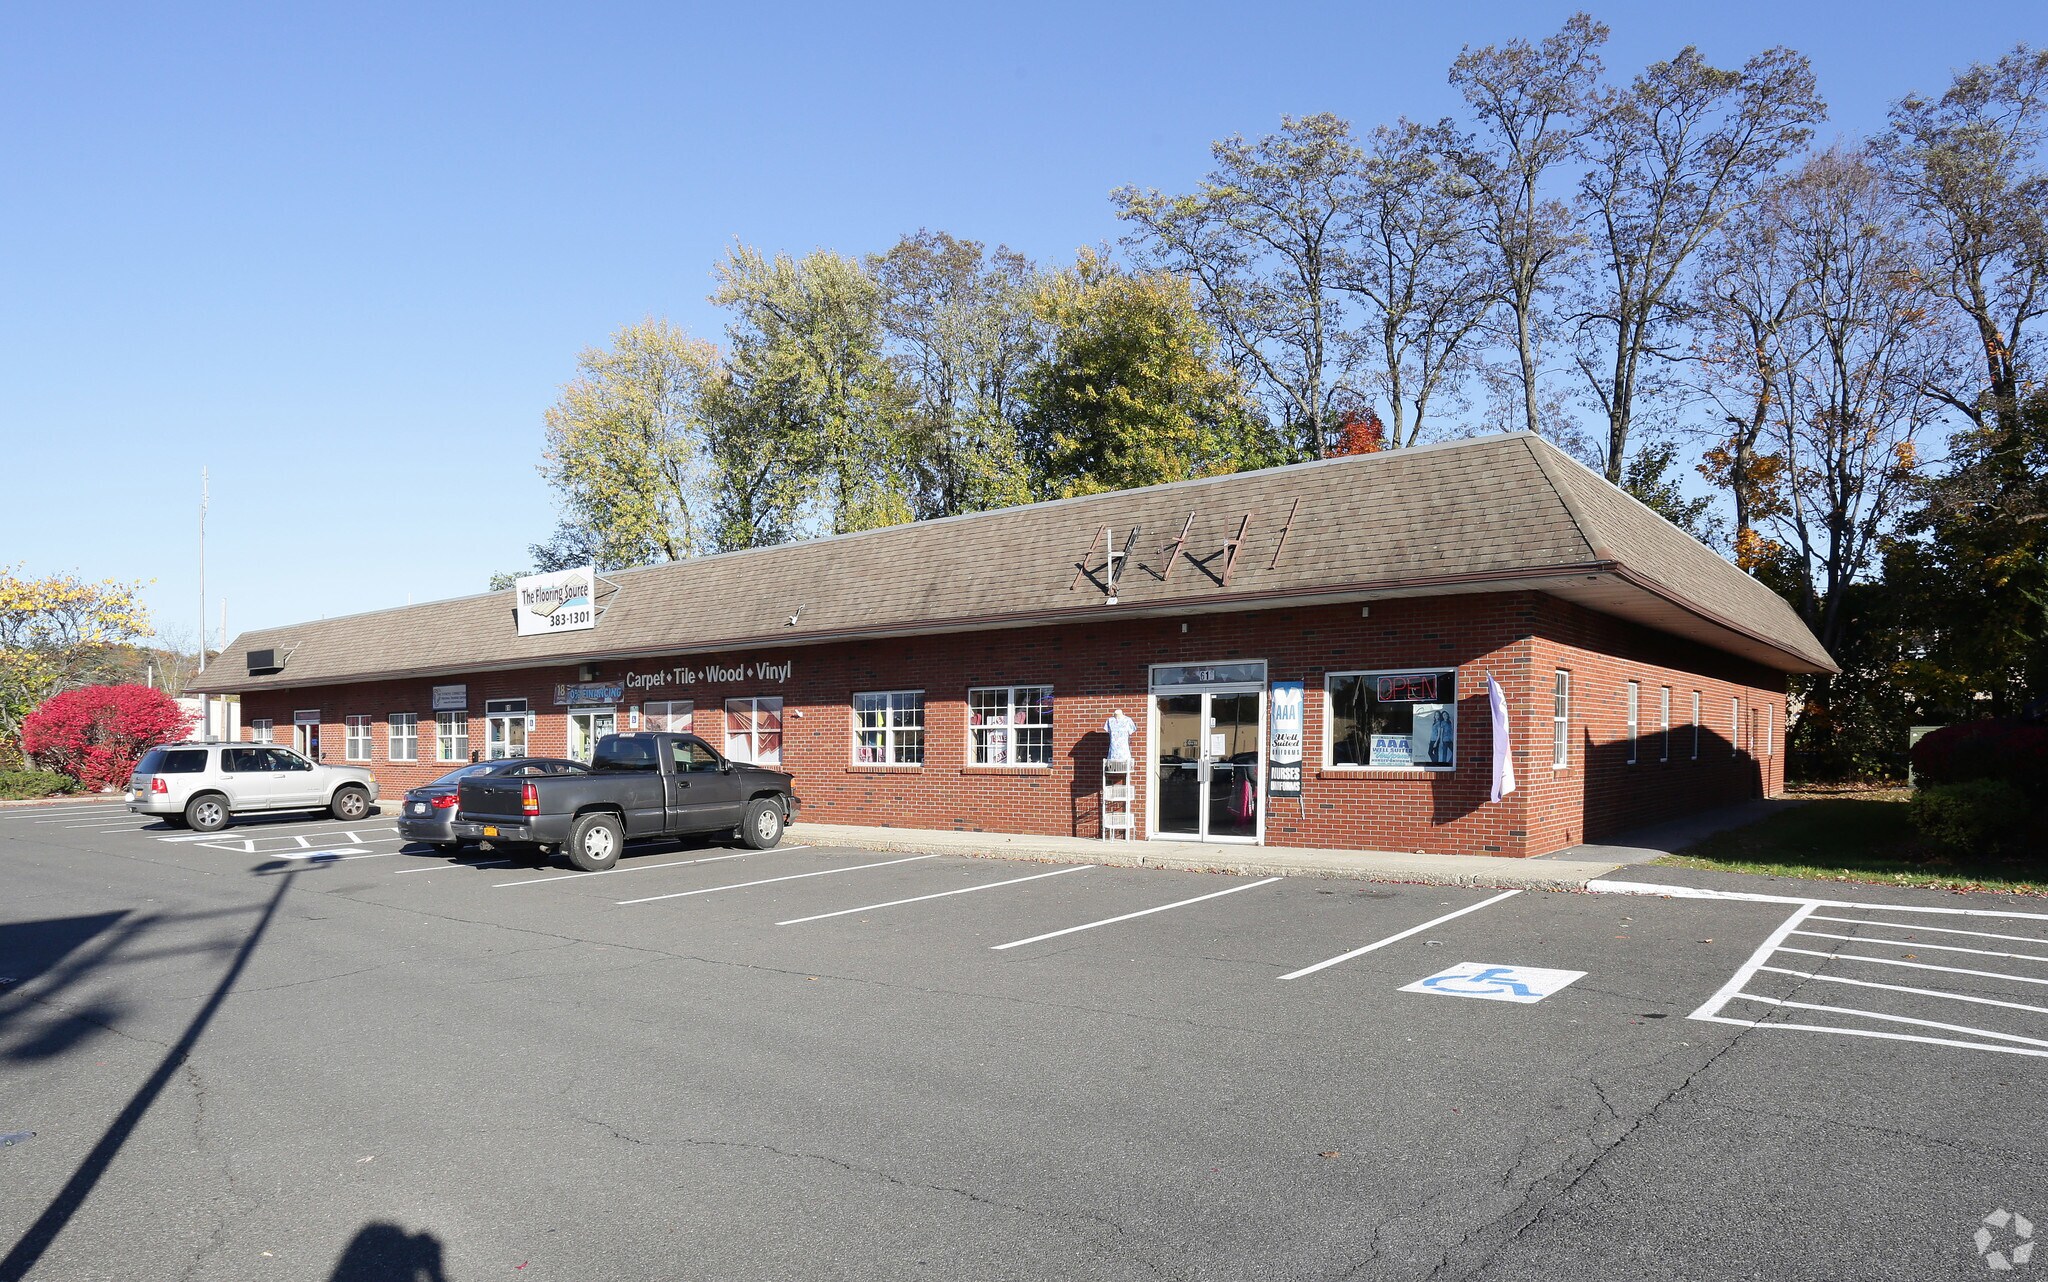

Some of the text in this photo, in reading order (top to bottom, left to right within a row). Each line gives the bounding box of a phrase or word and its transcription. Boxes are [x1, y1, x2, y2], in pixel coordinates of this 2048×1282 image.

[522, 584, 589, 605] The Flooring Source
[550, 611, 590, 627] 383-1301
[626, 660, 791, 690] Carpet Tile Wood Vinyl
[558, 684, 566, 696] 18
[583, 687, 622, 699] FINANCING
[1379, 676, 1437, 700] OPEN
[1276, 704, 1296, 720] AAA
[1275, 733, 1298, 741] Well
[1272, 740, 1300, 748] Suited
[1375, 739, 1410, 748] AAA
[1271, 767, 1301, 780] NURSES
[1270, 780, 1301, 792] UNIFORMS
